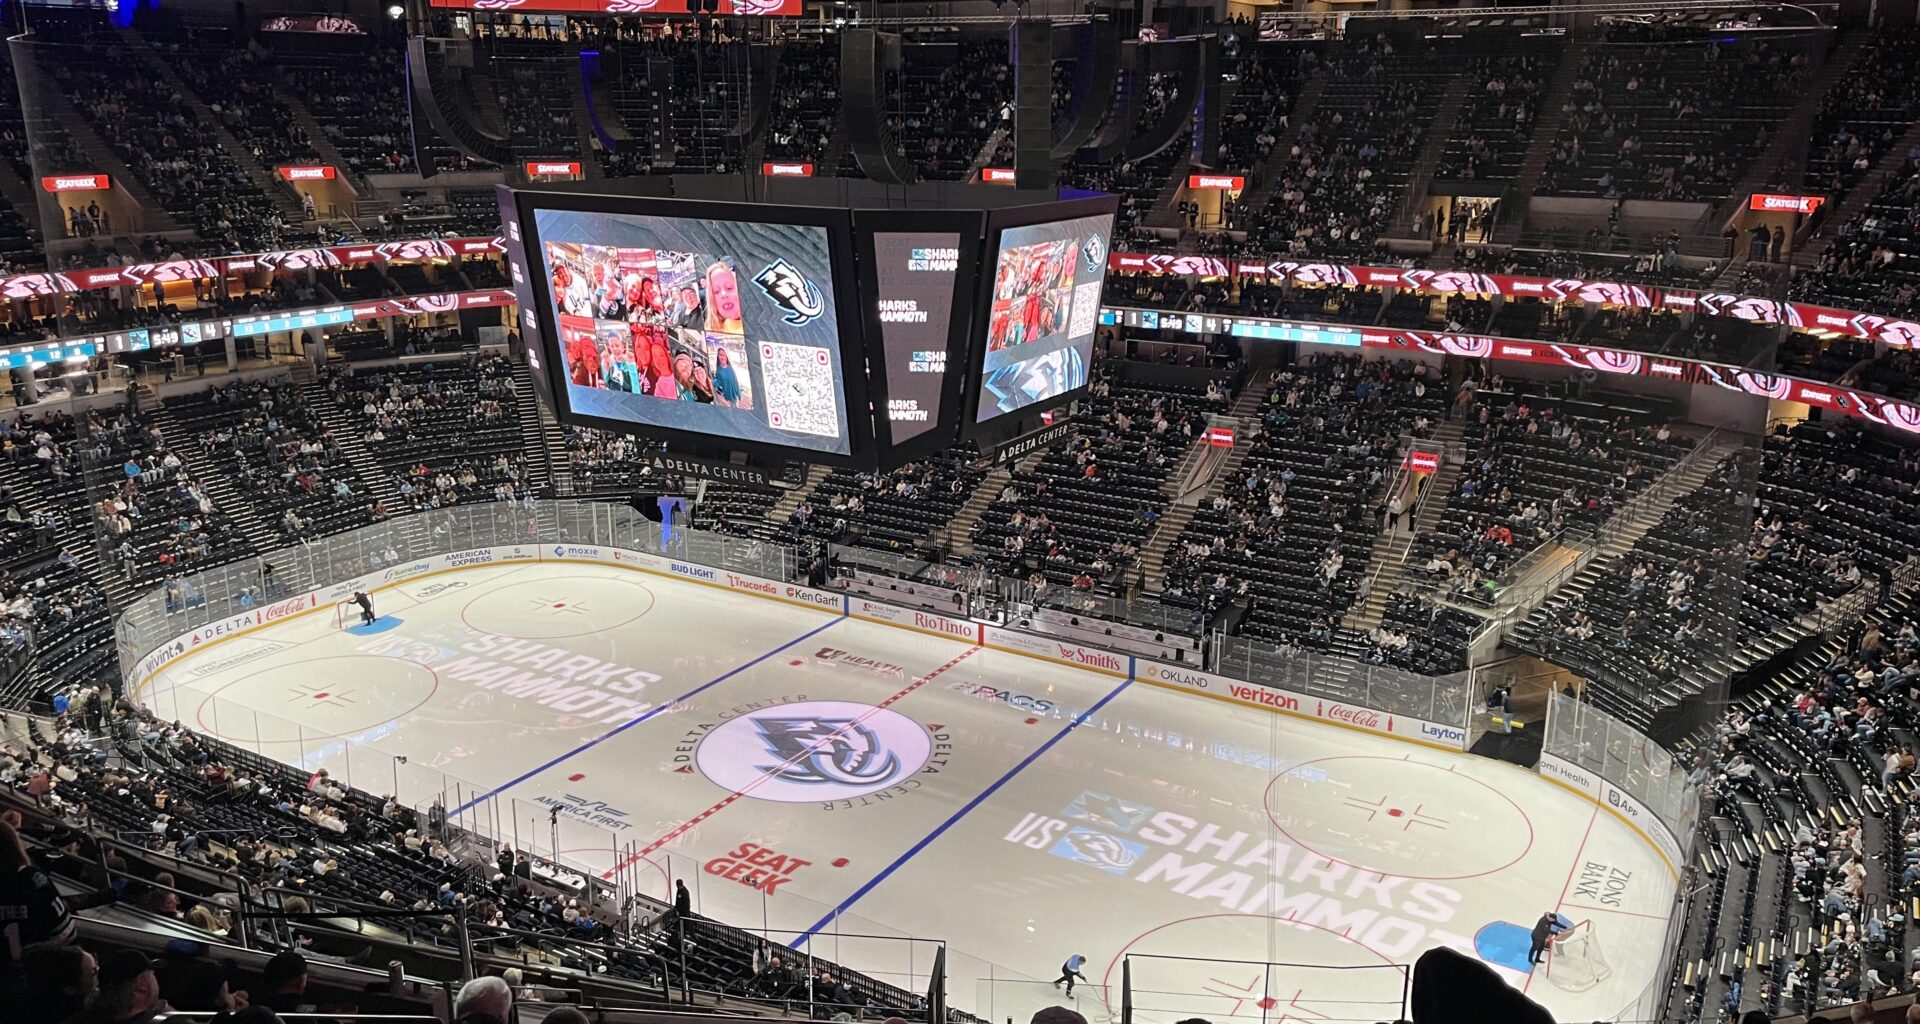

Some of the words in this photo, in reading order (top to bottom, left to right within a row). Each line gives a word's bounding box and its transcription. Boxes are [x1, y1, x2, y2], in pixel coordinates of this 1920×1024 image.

[56, 178, 96, 190] SEATGEEK
[290, 169, 324, 179] SEATGEEK
[153, 332, 178, 346] 5:49
[205, 323, 217, 337] 4
[116, 335, 123, 350] 1
[1009, 438, 1036, 458] DELTA
[1038, 425, 1068, 445] CENTER
[666, 459, 709, 475] DELTA
[713, 467, 763, 484] CENTER
[445, 549, 490, 561] AMERICAN
[452, 556, 492, 567] EXPRESS
[568, 547, 598, 556] moxie
[671, 564, 688, 574] BUD
[690, 567, 714, 579] LIGHT
[734, 577, 776, 594] Trucordia
[795, 588, 814, 602] Ken
[815, 593, 838, 608] Garff
[204, 616, 252, 639] DELTA
[146, 645, 174, 674] vivint
[461, 635, 662, 694] SHARKS
[844, 655, 904, 672] HEALTH
[1077, 647, 1121, 671] Smith's
[445, 655, 651, 725] MAMMOTH
[1161, 669, 1207, 688] OKLAND
[1229, 684, 1299, 711] verizon
[1328, 703, 1380, 728] Coca-Cola
[674, 723, 715, 763] DELTA
[718, 694, 809, 719] CENTER
[1422, 722, 1465, 741] Layton
[922, 733, 953, 774] DELTA
[1560, 764, 1590, 788] Health
[822, 780, 922, 811] CENTER
[1620, 799, 1639, 818] App
[590, 814, 633, 831] FIRST
[1004, 811, 1067, 850] VS
[728, 842, 813, 876] SEAT
[1138, 810, 1464, 924] SHARKS
[703, 857, 793, 897] GEEK
[1574, 861, 1607, 900] BANK
[1600, 867, 1632, 907] ZIONS
